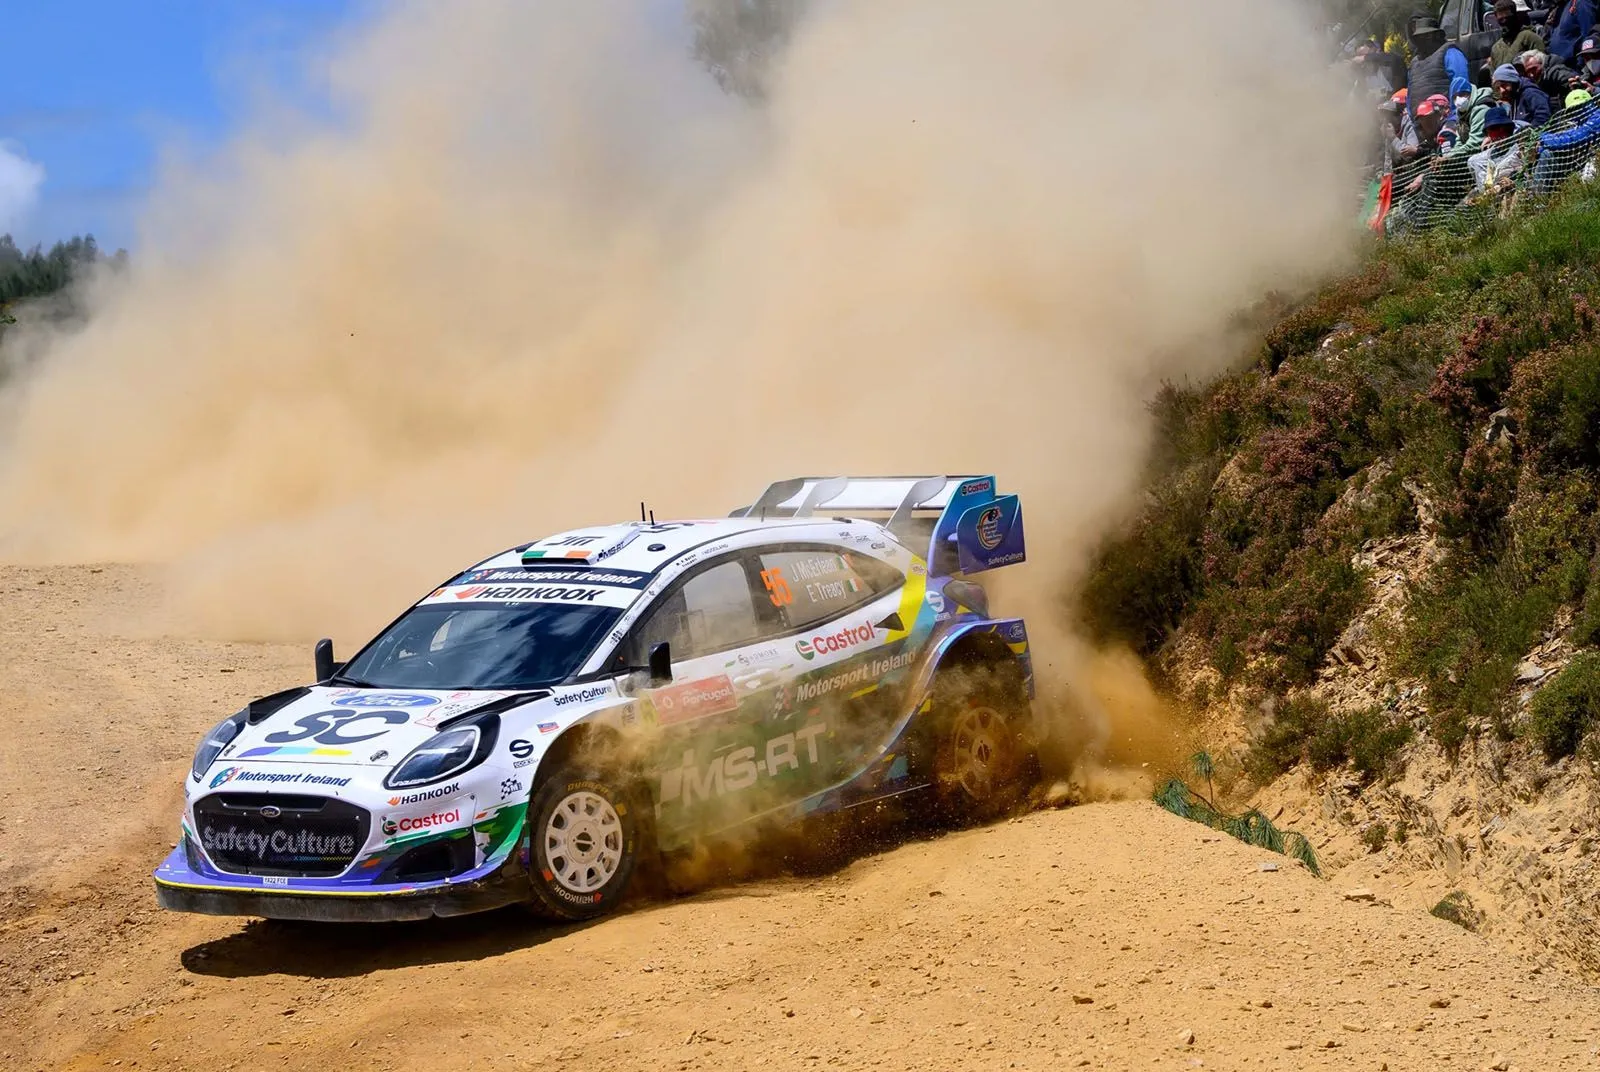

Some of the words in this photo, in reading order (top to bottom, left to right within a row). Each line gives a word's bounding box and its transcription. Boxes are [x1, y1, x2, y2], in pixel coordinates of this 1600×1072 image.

[967, 480, 990, 493] Castrol
[485, 570, 577, 582] Motorsport
[576, 571, 643, 585] Ireland
[791, 562, 799, 582] J
[760, 567, 793, 608] 55
[807, 584, 817, 602] E
[815, 580, 847, 600] Treacy
[812, 620, 876, 655] Castrol
[796, 666, 869, 702] Motorsport
[872, 648, 917, 678] Ireland
[346, 693, 425, 706] Ford
[553, 686, 612, 706] SafetyCulture
[682, 686, 734, 707] Portugal
[264, 709, 411, 746] SC
[235, 771, 302, 785] Motorsport
[301, 774, 352, 788] Ireland
[398, 808, 461, 833] Castrol
[203, 825, 355, 861] SafetyCulture
